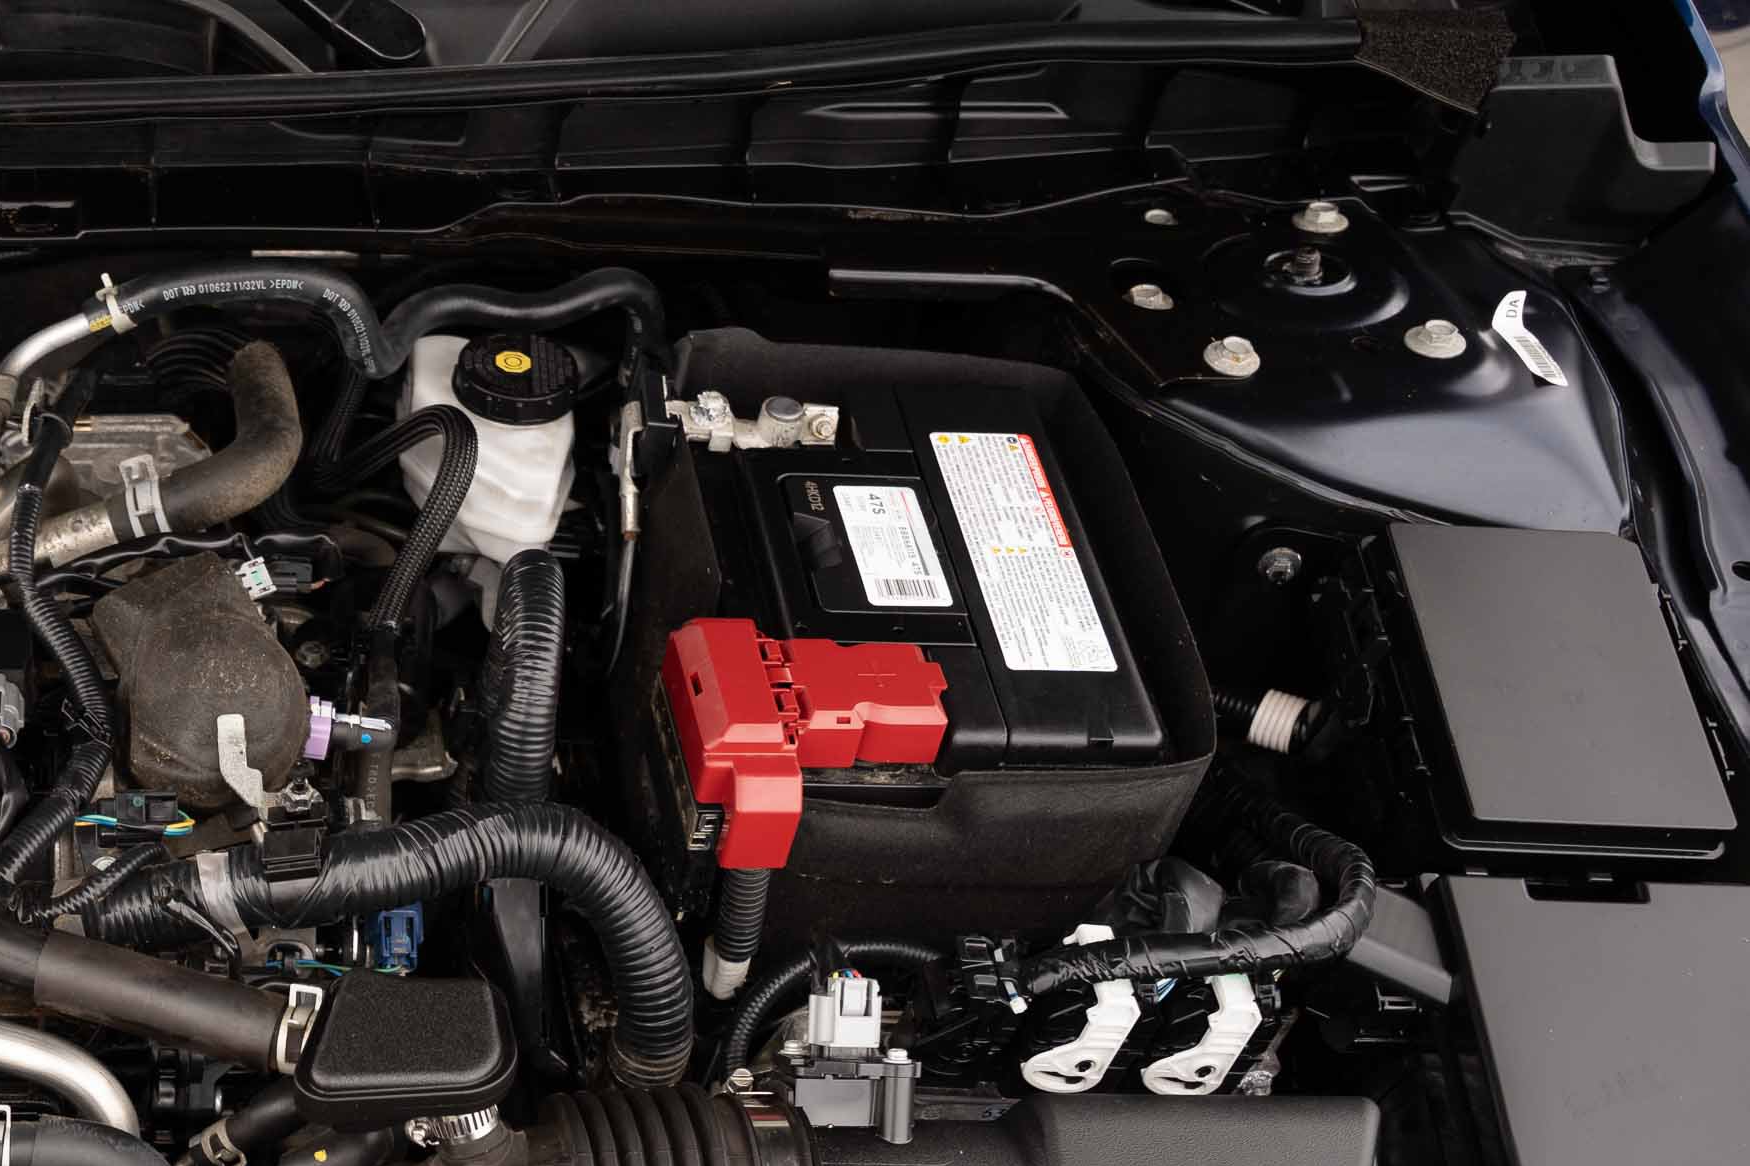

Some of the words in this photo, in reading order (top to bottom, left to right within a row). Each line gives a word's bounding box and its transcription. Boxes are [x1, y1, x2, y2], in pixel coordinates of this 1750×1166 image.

[162, 287, 179, 301] DOT
[322, 288, 340, 303] DOT
[1505, 299, 1520, 318] DA
